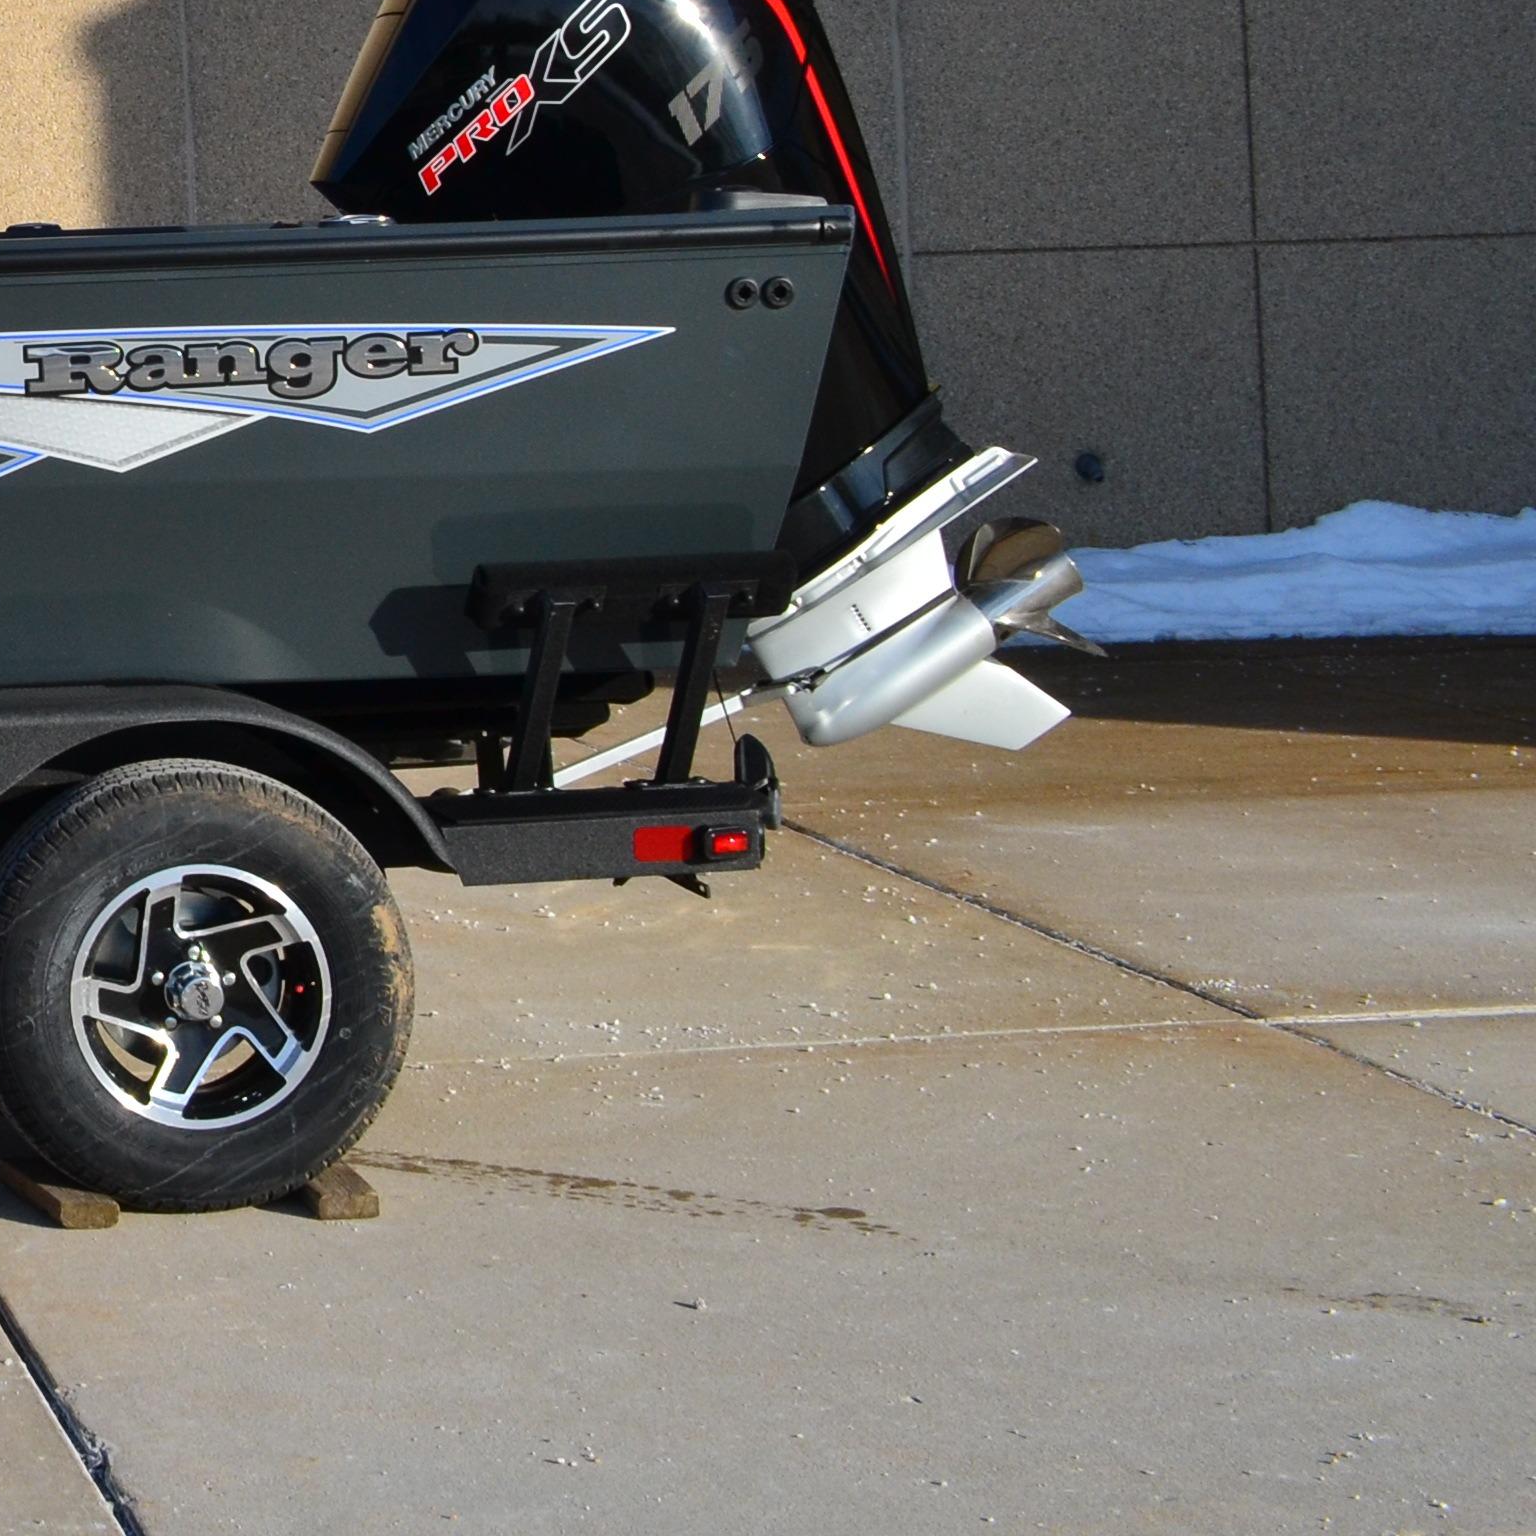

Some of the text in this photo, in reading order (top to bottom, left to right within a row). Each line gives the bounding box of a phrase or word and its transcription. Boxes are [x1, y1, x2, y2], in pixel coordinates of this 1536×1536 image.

[407, 64, 496, 161] MERCURY
[418, 73, 535, 196] PRO
[23, 327, 480, 400] Ranger
